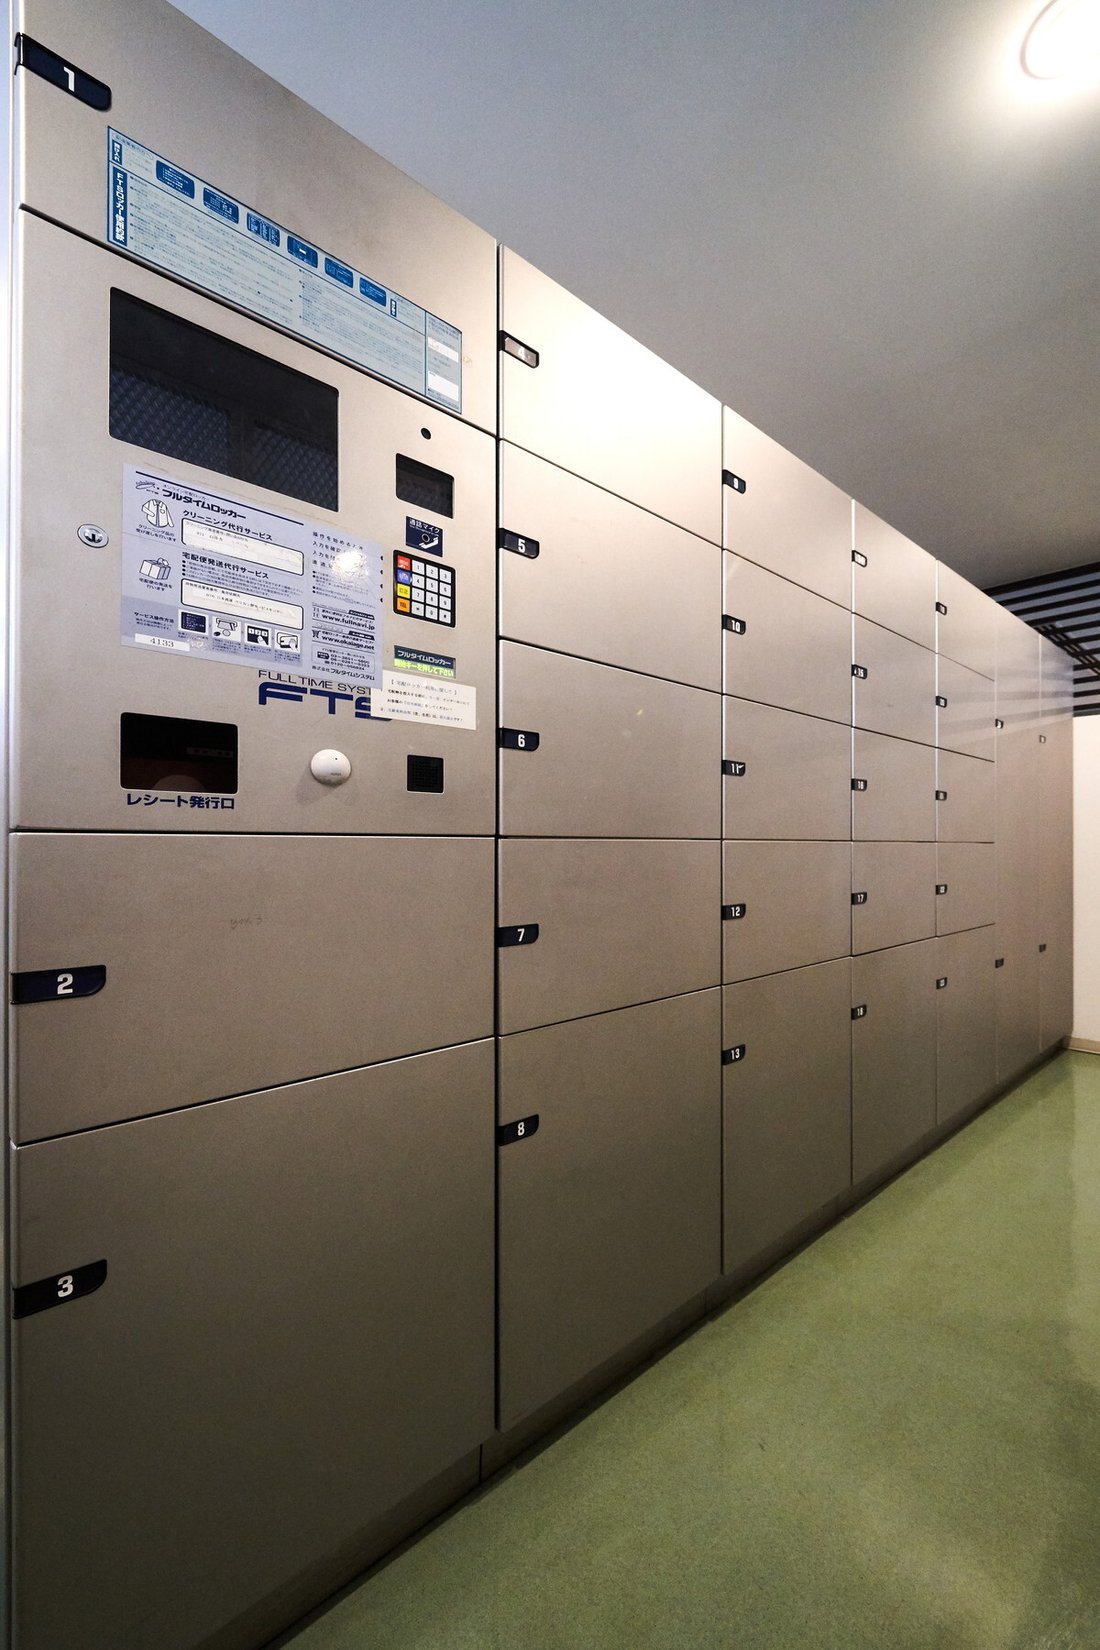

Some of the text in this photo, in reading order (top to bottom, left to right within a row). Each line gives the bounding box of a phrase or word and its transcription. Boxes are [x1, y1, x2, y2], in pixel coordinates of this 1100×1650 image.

[63, 66, 75, 92] 1
[733, 477, 739, 489] 9
[162, 488, 247, 519] フルタイムロッカー
[183, 510, 273, 541] クリーニング代行サービス
[517, 538, 526, 553] 5
[182, 552, 269, 579] 宅配便発送代行サービス
[322, 614, 375, 631] www.fullnavi.jp
[731, 619, 741, 632] 10
[150, 638, 174, 648] 4133
[397, 650, 451, 665] フルタイムロッカー
[518, 733, 525, 748] 6
[127, 793, 235, 810] レシート発行口
[731, 906, 741, 917] 12
[517, 928, 525, 942] 7
[57, 973, 73, 995] 2
[731, 1048, 740, 1059] 13
[517, 1121, 525, 1136] 8
[57, 1275, 73, 1297] 3
